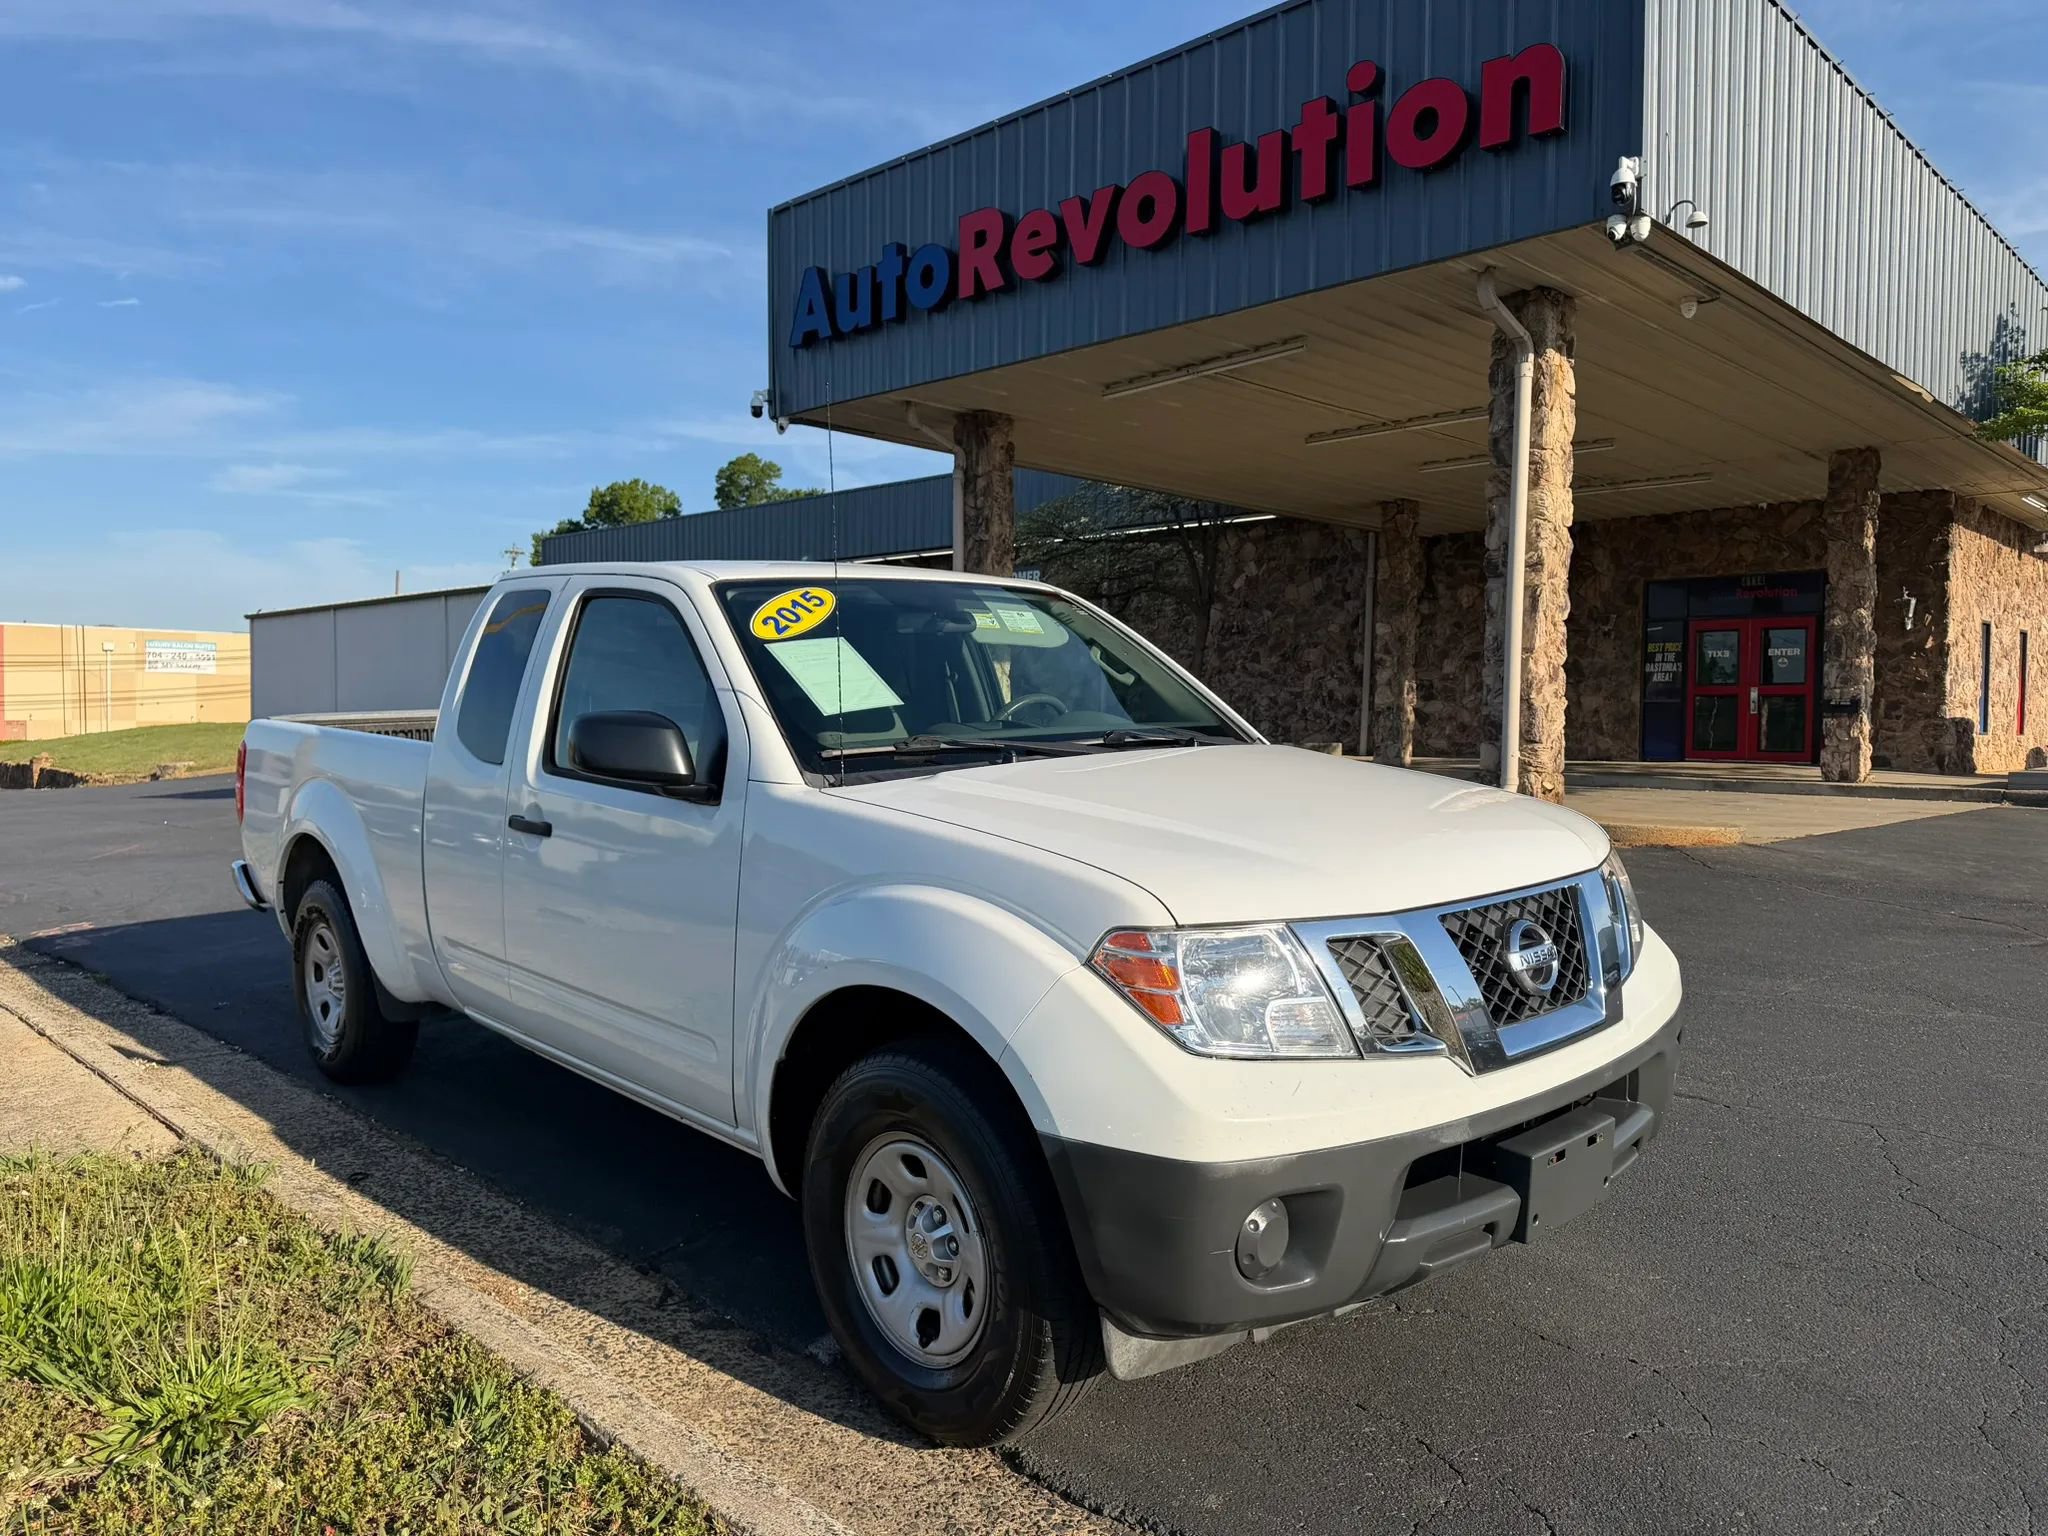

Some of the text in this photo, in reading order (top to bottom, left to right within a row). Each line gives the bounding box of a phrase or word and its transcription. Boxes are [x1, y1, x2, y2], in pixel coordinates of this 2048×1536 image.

[761, 590, 825, 636] 2015
[1648, 642, 1683, 652] BEST PRICE
[1768, 647, 1801, 656] ENTER
[1655, 652, 1676, 662] IN THE
[1652, 672, 1673, 682] AREA!
